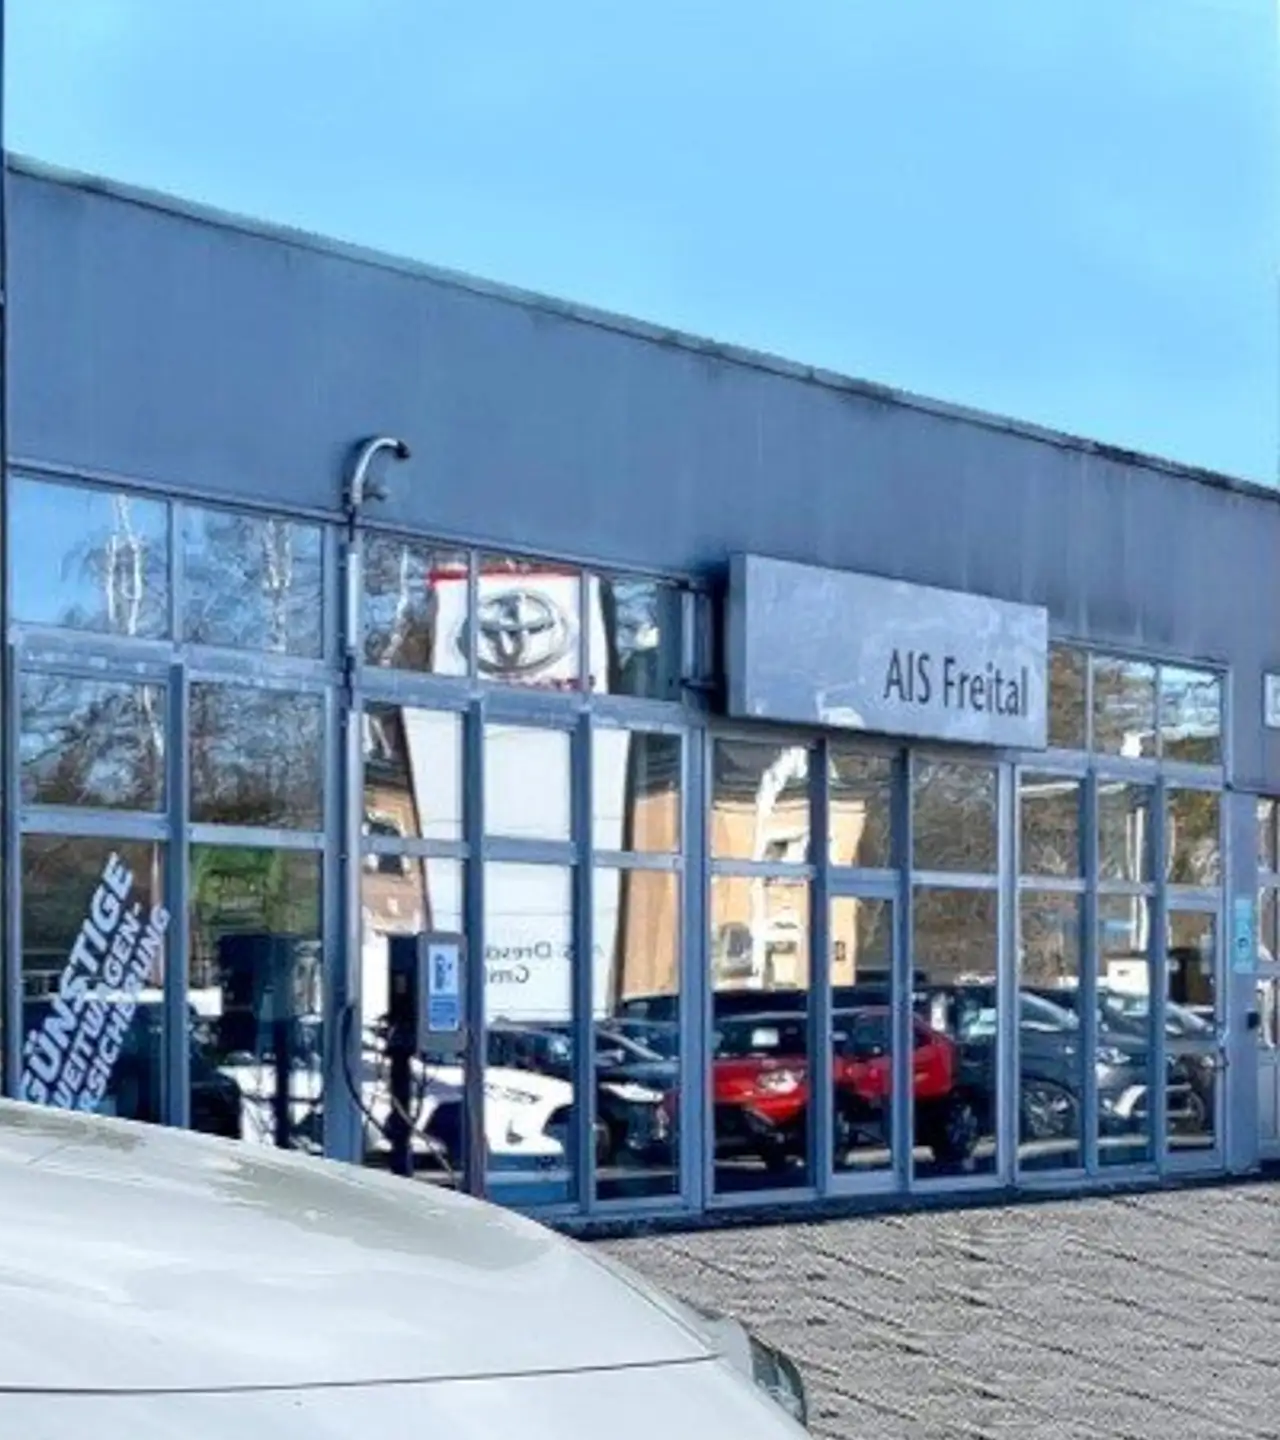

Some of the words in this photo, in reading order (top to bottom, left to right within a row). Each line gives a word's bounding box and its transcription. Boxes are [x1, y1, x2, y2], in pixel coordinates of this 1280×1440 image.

[883, 649, 931, 705] AIS
[943, 656, 1029, 717] Freital
[17, 851, 134, 1107] GÜNSTIGE
